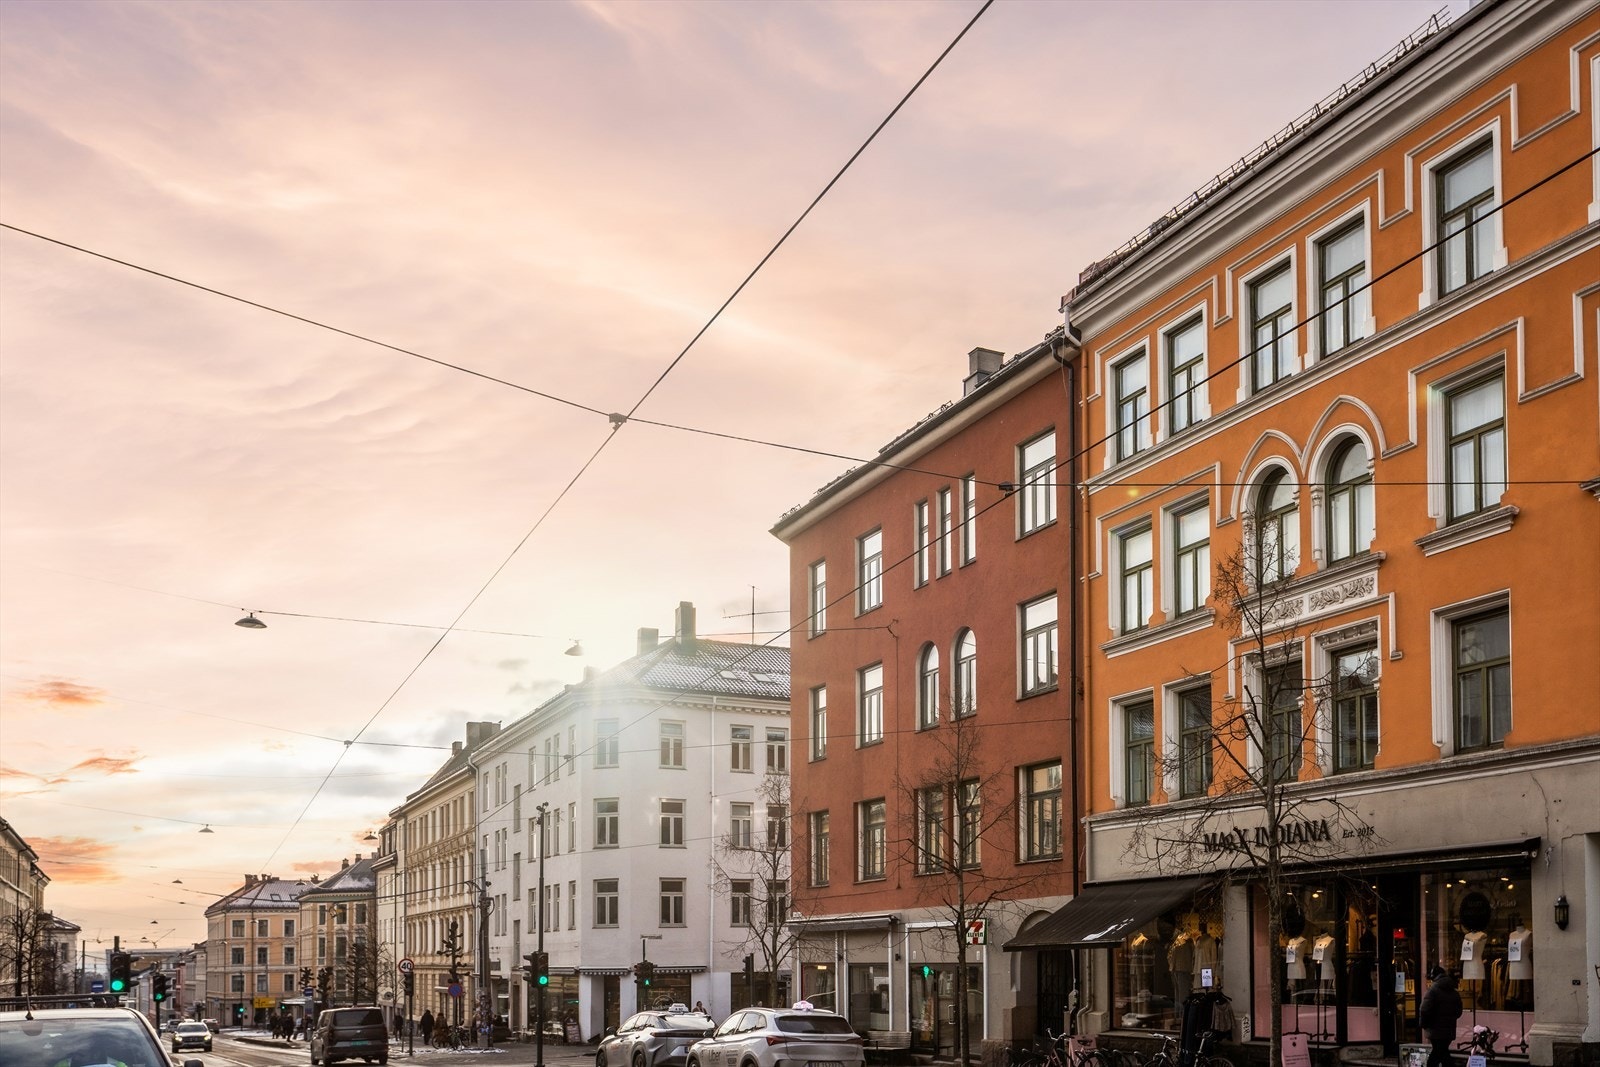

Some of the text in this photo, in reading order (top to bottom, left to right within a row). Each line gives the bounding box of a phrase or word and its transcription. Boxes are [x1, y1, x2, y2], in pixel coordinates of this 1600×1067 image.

[968, 921, 983, 944] 7
[401, 962, 411, 970] 40
[708, 1049, 722, 1061] Uber
